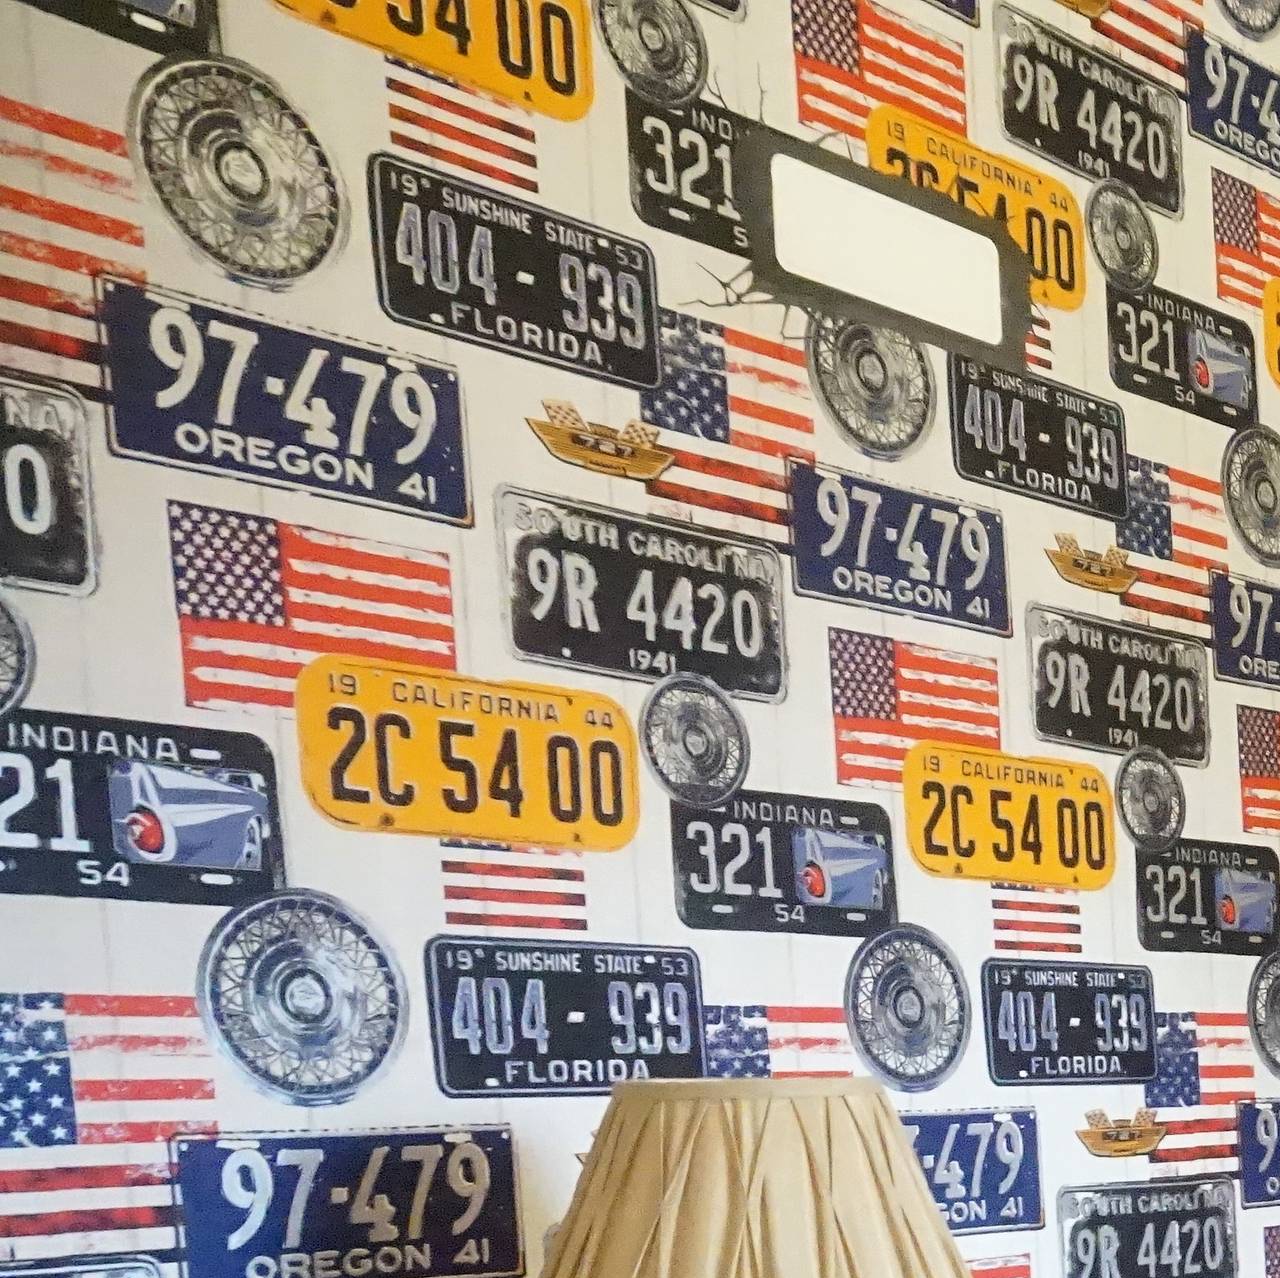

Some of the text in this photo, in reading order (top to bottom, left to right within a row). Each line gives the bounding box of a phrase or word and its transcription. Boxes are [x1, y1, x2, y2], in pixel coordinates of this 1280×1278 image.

[1011, 56, 1059, 135] 9R
[1076, 89, 1169, 180] 4420
[389, 168, 644, 272] 19 SUNSHINE STATE 53
[453, 304, 603, 366] FLORIDA
[1116, 305, 1181, 381] 321
[149, 302, 437, 465] 97-479
[175, 422, 436, 504] OREGON 41
[819, 477, 991, 594] 97-479
[526, 545, 761, 660] 9R 4420
[832, 566, 953, 613] OREGON
[629, 647, 677, 672] 1941
[328, 672, 614, 729] 19 CALIFORNIA 44
[326, 705, 623, 828] 2C 54 00
[960, 758, 1064, 789] CALIFORNIA
[732, 802, 834, 828] INDIANA
[920, 779, 1108, 872] 2C 54 00
[685, 817, 784, 900] 321
[446, 949, 689, 978] 19 SUNSHINE STATE 53
[452, 975, 550, 1057] 404
[608, 980, 691, 1056] 939
[998, 989, 1148, 1053] 404 939
[503, 1057, 652, 1084] FLORIDA
[1030, 1054, 1122, 1075] FLORIDA
[220, 1141, 492, 1253] 97-479
[452, 1236, 491, 1265] 41
